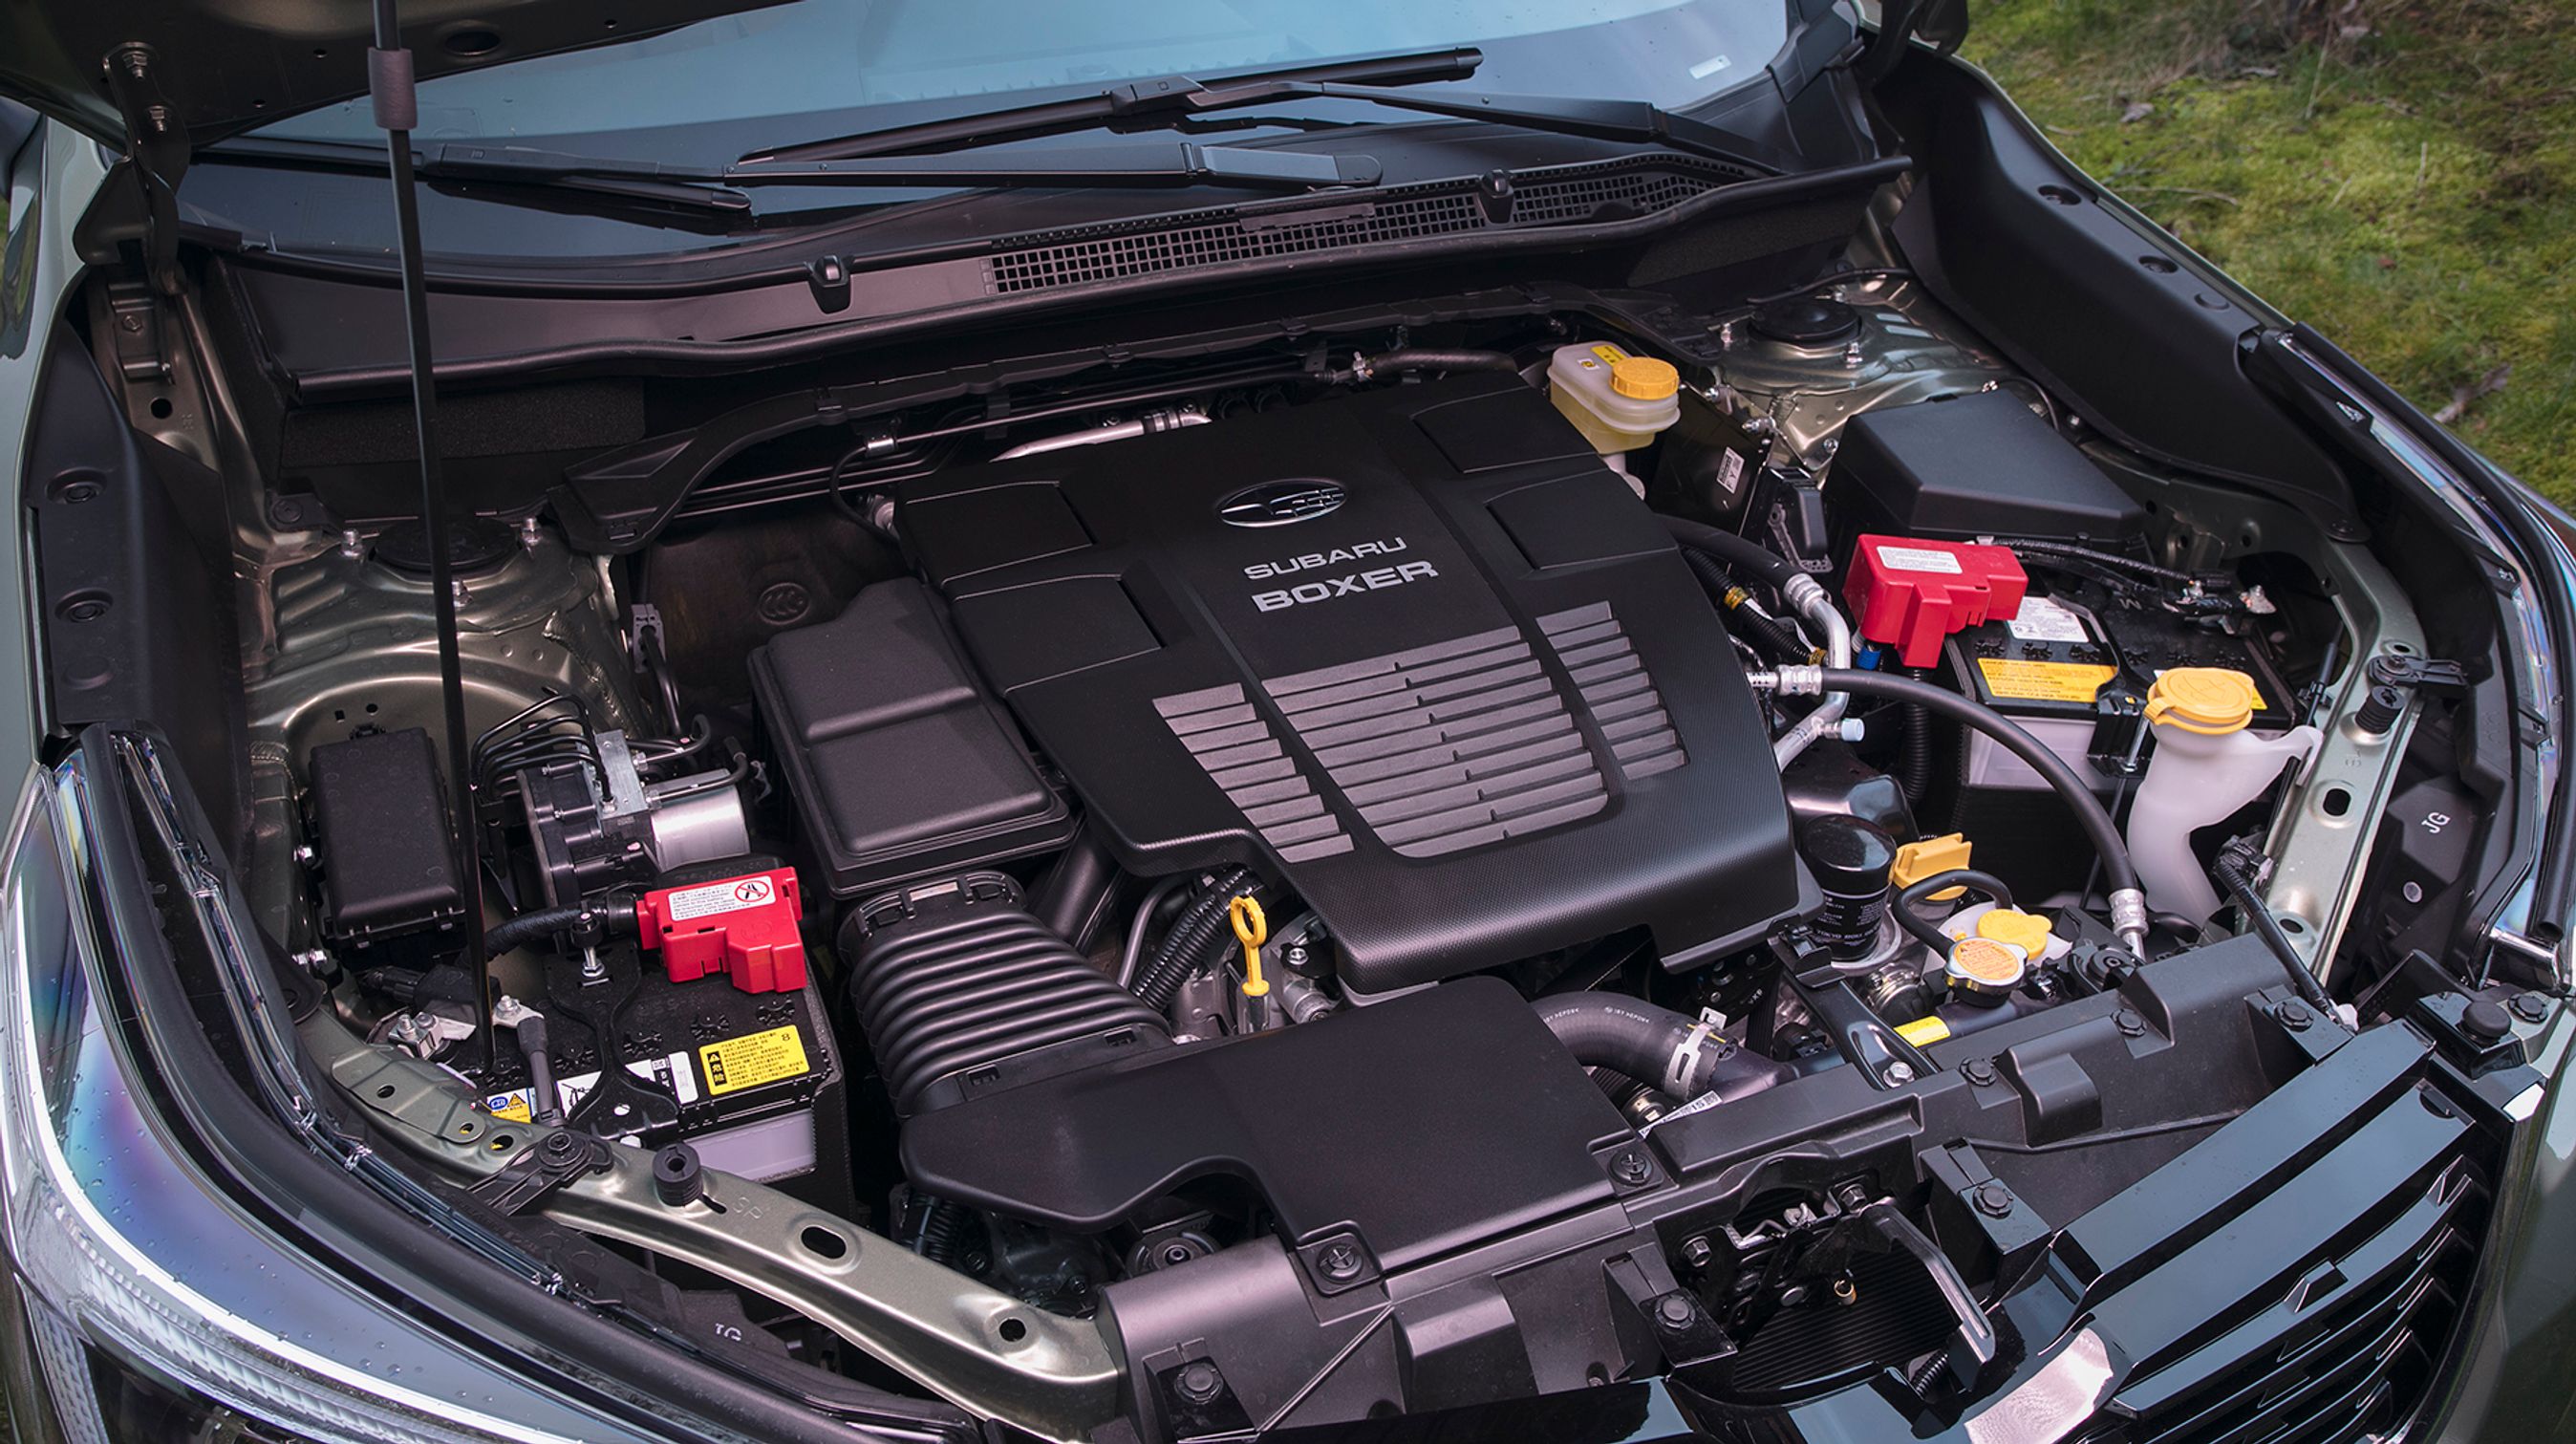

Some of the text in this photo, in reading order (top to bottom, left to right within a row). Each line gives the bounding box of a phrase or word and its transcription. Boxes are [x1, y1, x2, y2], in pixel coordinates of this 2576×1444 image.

[1244, 537, 1407, 580] SUBARU
[1252, 561, 1439, 613] BOXER
[2421, 811, 2451, 833] JG
